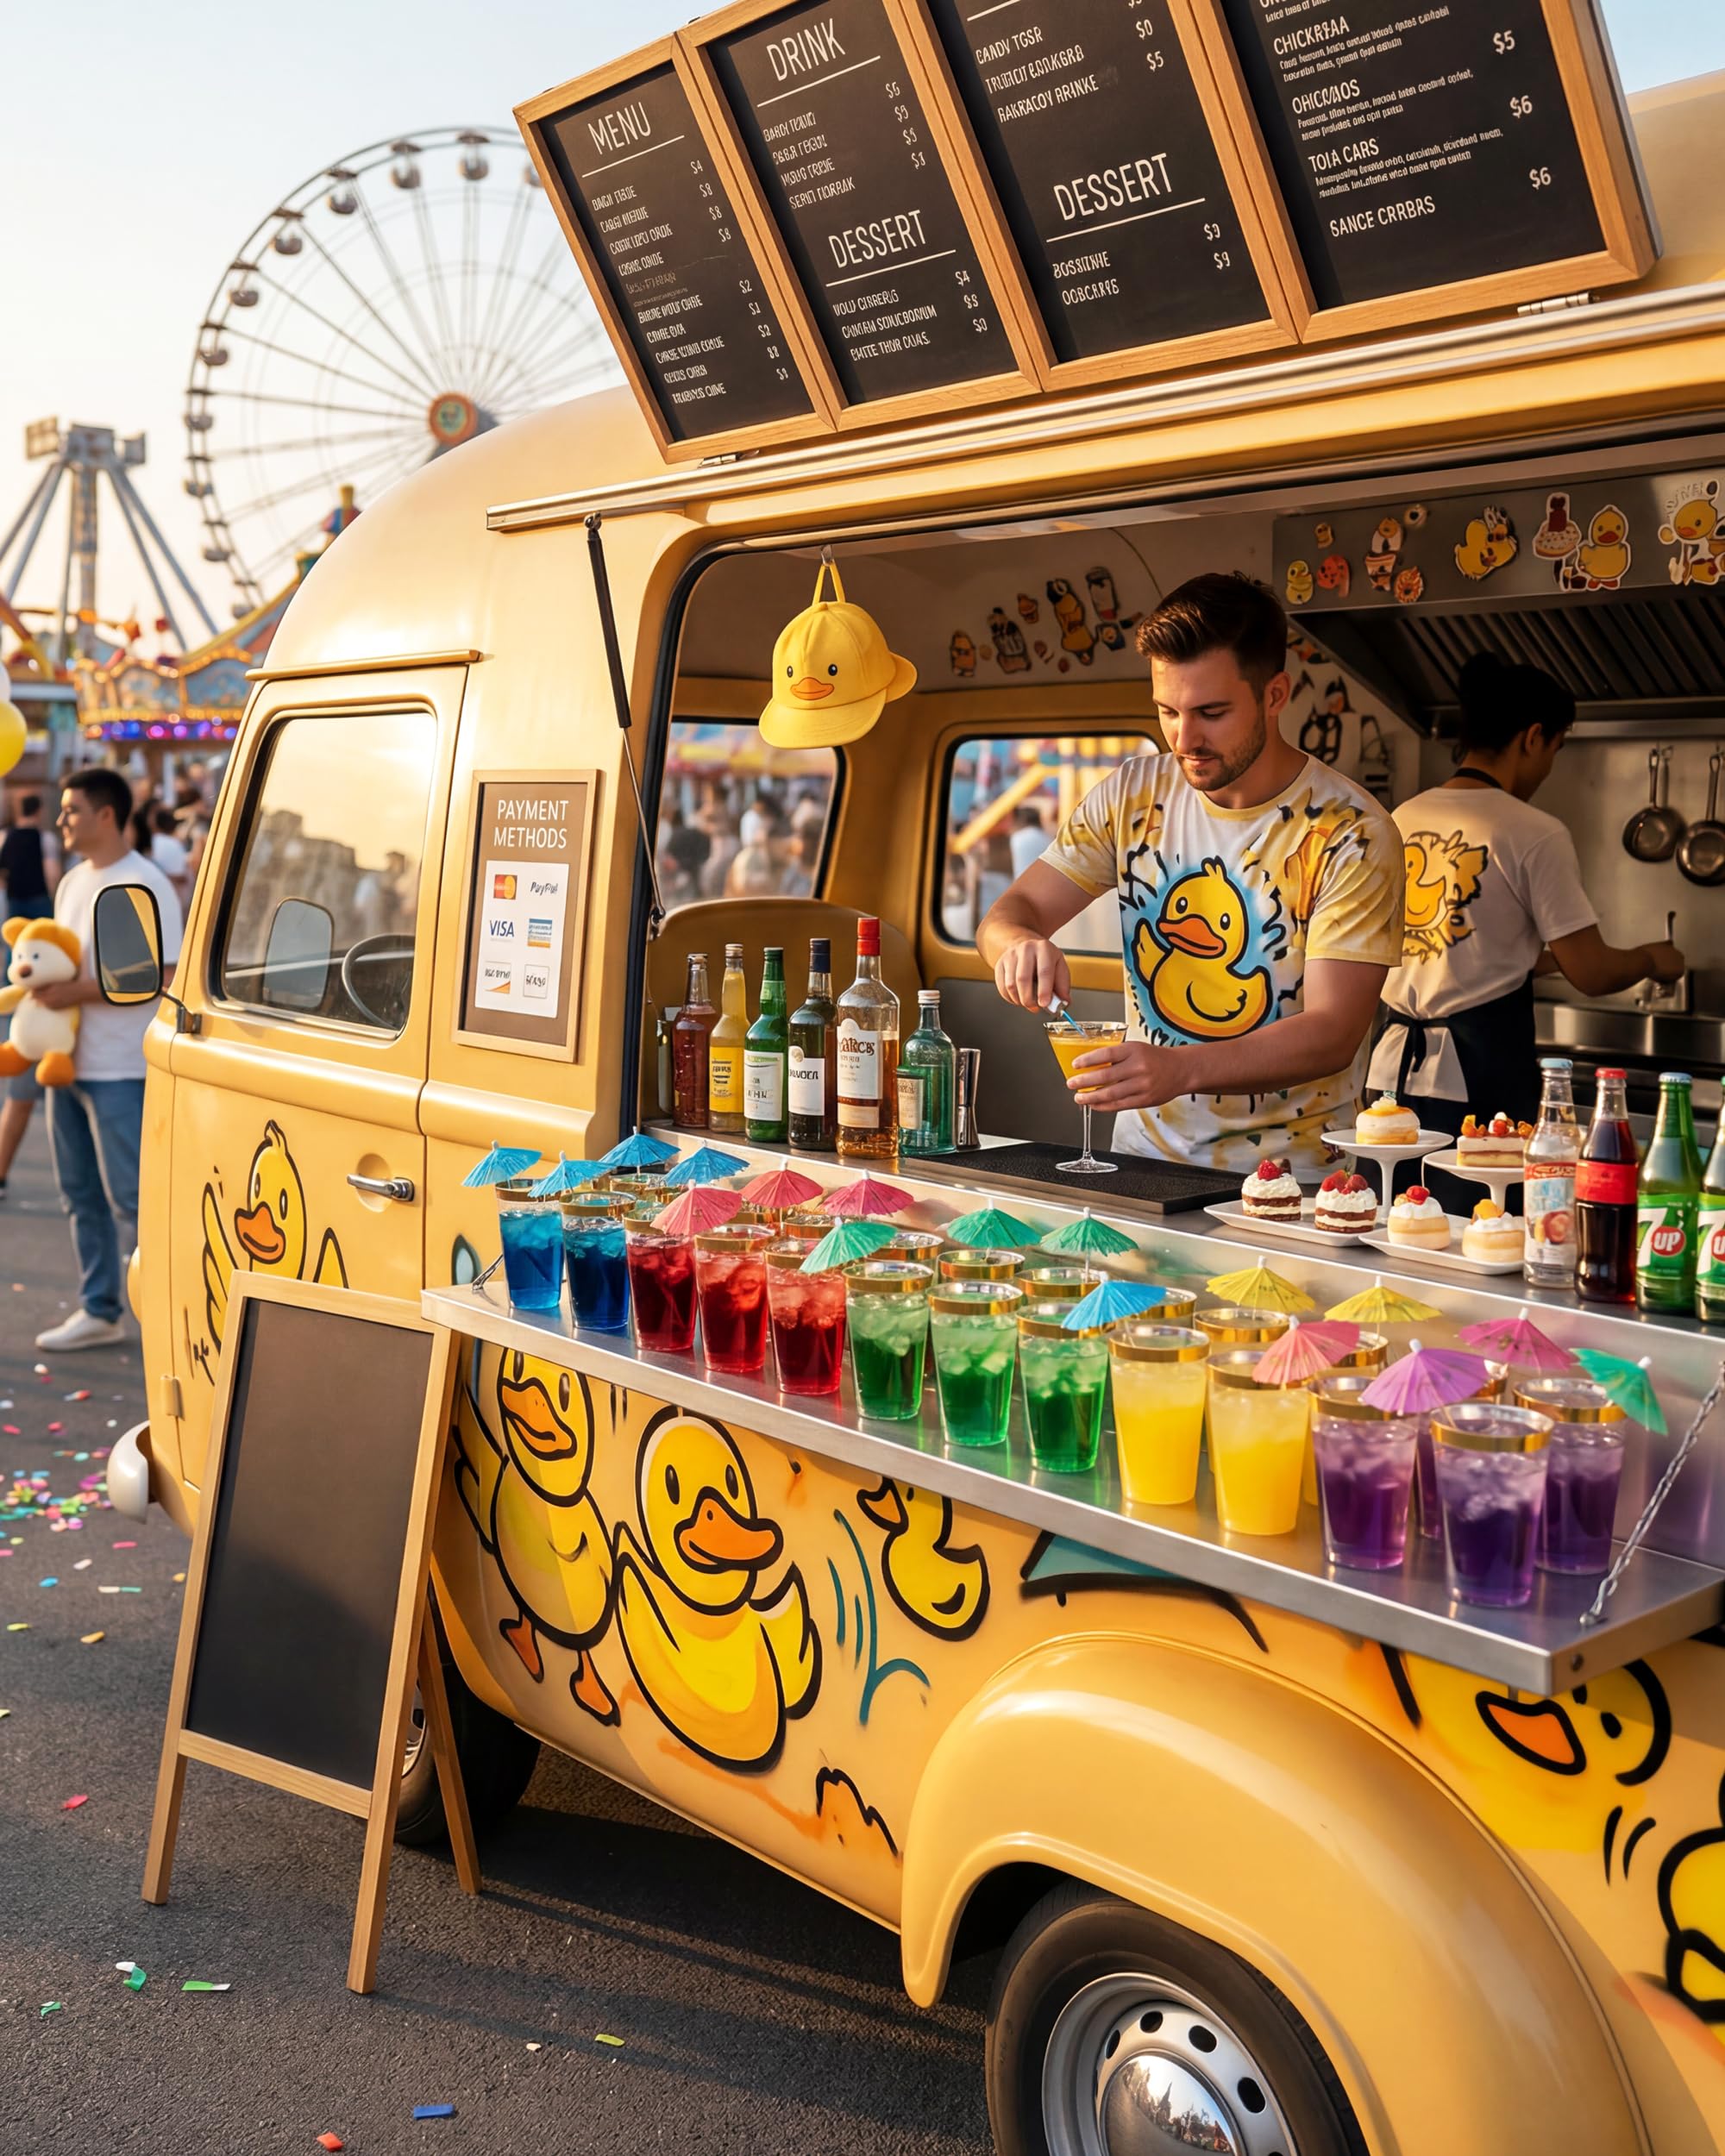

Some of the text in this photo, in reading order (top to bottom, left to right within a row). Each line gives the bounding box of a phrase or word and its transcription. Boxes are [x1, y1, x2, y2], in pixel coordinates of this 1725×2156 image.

[766, 17, 846, 82] DRINK
[1493, 30, 1515, 54] $5
[1146, 51, 1164, 72] $5
[1509, 95, 1533, 119] $6
[588, 102, 651, 155] MENU
[1342, 138, 1380, 164] CARS
[1053, 153, 1172, 221] DESSERT
[1529, 166, 1552, 191] $6
[828, 210, 926, 268] DESSERT
[497, 799, 569, 821] PAYMENT
[493, 827, 567, 849] METHODS
[490, 919, 515, 937] VISA
